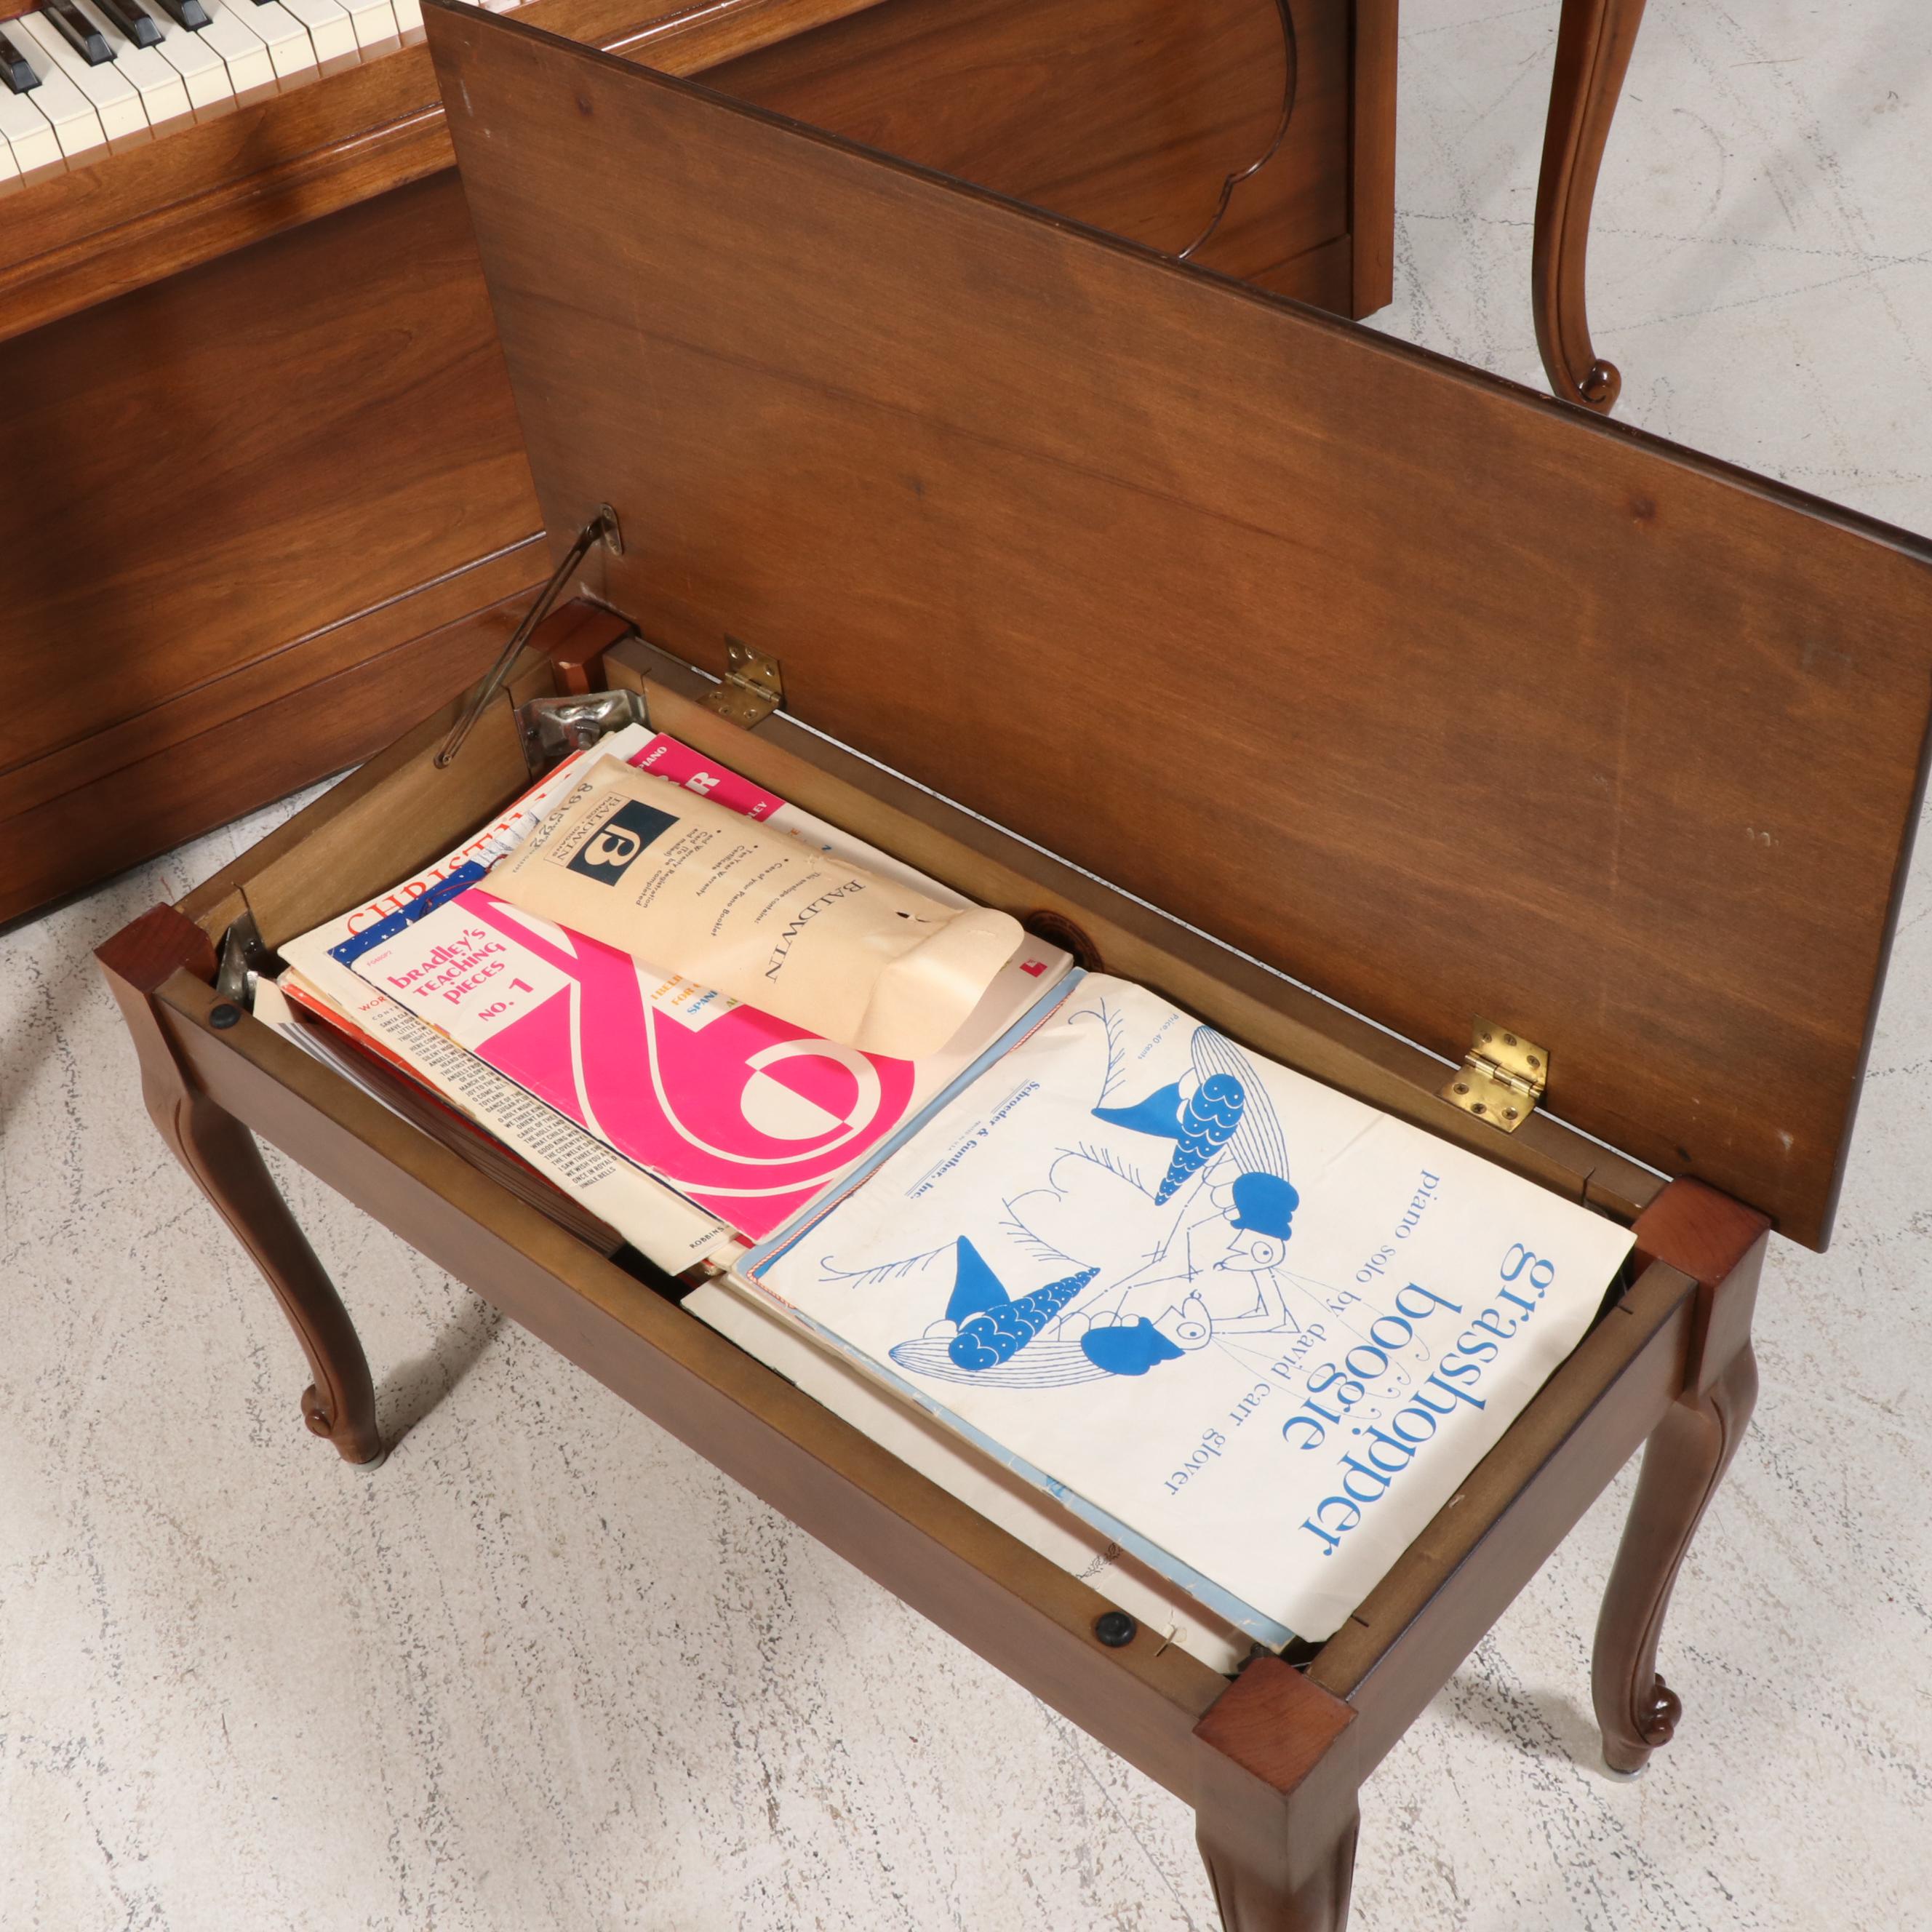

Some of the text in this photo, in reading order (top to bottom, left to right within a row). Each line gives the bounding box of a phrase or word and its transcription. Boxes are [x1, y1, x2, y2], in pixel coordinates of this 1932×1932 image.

[557, 797, 622, 861] BALDWIN
[673, 839, 704, 868] Warranty
[712, 845, 745, 875] Certificate
[765, 863, 783, 874] Care
[636, 870, 663, 906] completed
[638, 869, 675, 909] Registration
[696, 866, 727, 897] Warranty
[743, 878, 758, 890] your
[727, 891, 746, 907] Piano
[711, 909, 730, 936] Booklet
[765, 879, 866, 983] BALDWIN
[508, 977, 535, 994] 1
[380, 1017, 399, 1028] SANTA
[386, 1023, 402, 1033] HAVE
[397, 1023, 416, 1034] LITTLE
[410, 1033, 427, 1043] EIGHT
[410, 1042, 425, 1051] HERE
[415, 1047, 431, 1056] STAR
[1138, 1043, 1153, 1060] cents
[422, 1050, 442, 1062] SILENT
[429, 1054, 450, 1067] ANGELS
[440, 1057, 459, 1068] HEARD
[440, 1069, 453, 1077] THE
[451, 1060, 468, 1071] FIRST
[447, 1069, 469, 1082] ANGELS
[467, 1066, 485, 1078] GLORY
[459, 1079, 480, 1092] MARCH
[466, 1088, 476, 1097] JOY
[494, 1081, 507, 1090] ALL
[479, 1092, 504, 1107] TOYLAND
[485, 1101, 504, 1113] DANCE
[989, 1082, 1040, 1126] Schroeder
[497, 1102, 516, 1114] SUGAR
[502, 1109, 518, 1119] HOLY
[517, 1100, 535, 1111] NIGHT
[513, 1111, 532, 1122] THREE
[516, 1115, 537, 1130] ORIENT
[516, 1126, 537, 1138] CAROL
[524, 1135, 537, 1143] THE
[534, 1125, 553, 1138] HOLLY
[531, 1138, 548, 1149] WHAT
[546, 1128, 564, 1140] CHILD
[976, 1128, 989, 1136] &
[538, 1143, 554, 1155] GOOD
[553, 1135, 568, 1145] KING
[544, 1133, 585, 1160] THE COVENTRY
[551, 1157, 564, 1165] THE
[562, 1145, 584, 1159] TWELVE
[561, 1160, 575, 1170] SAW
[573, 1150, 592, 1162] THREE
[573, 1161, 590, 1172] WISH
[588, 1154, 602, 1164] YOU
[572, 1173, 588, 1183] ONCE
[593, 1159, 613, 1171] ROYAL
[597, 1163, 616, 1179] BELLS
[911, 1183, 934, 1199] Inc.
[690, 1226, 725, 1249] ROBBINS
[1164, 1170, 1440, 1496] piano solo by david carr glover
[1282, 1282, 1463, 1450] boogie
[1298, 1242, 1554, 1557] grasshopper
